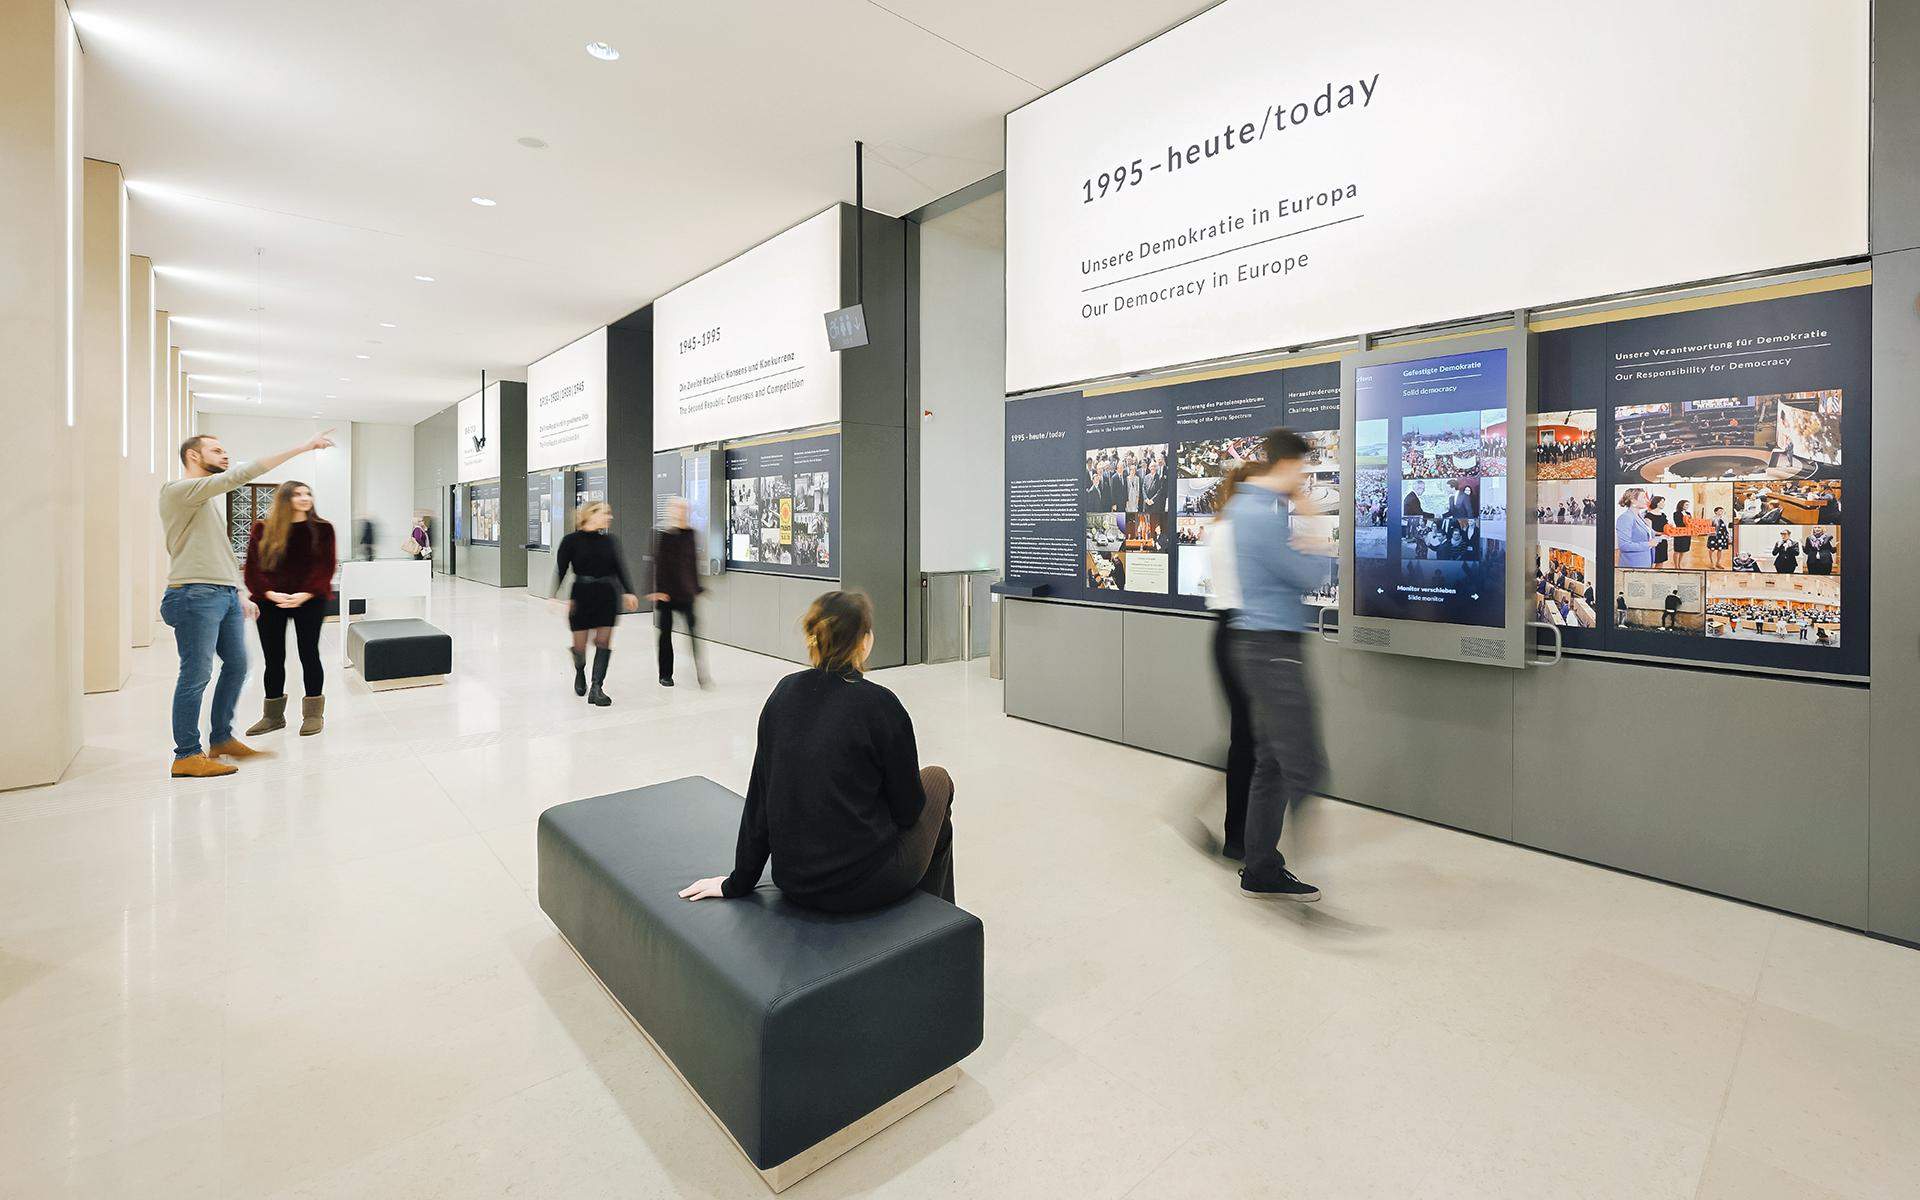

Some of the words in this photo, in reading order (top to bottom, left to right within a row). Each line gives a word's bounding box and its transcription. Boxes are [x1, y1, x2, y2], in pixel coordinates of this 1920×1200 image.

[1081, 248, 1134, 275] Unsere
[1139, 214, 1245, 260] Demokratie
[1252, 208, 1270, 225] in
[1278, 182, 1358, 218] Europa
[1081, 302, 1109, 319] Our
[1114, 277, 1205, 313] Democracy
[1213, 271, 1228, 288] in
[1238, 252, 1309, 282] Europe
[1615, 349, 1650, 361] Unsere
[1652, 340, 1733, 357] Verantwortung
[1736, 336, 1753, 348] für
[1756, 328, 1828, 345] Demokratie
[726, 366, 748, 379] Konsens
[748, 362, 759, 371] und
[759, 352, 795, 368] Konkurrenz
[1402, 367, 1438, 377] Gefestigte
[1439, 361, 1482, 373] Demokratie
[1615, 371, 1633, 381] Our
[1636, 365, 1707, 380] Responsibility
[1709, 362, 1725, 372] for
[1729, 357, 1792, 370] Democracy
[726, 391, 754, 404] Consensus
[755, 387, 765, 398] and
[766, 378, 804, 395] Competition
[1402, 388, 1420, 397] Solid
[1420, 385, 1457, 395] democracy
[1228, 413, 1252, 421] Spectrum
[1288, 405, 1319, 414] Challenges
[1396, 585, 1420, 593] Monitor
[1420, 585, 1457, 594] verschieben
[1421, 595, 1445, 603] monitor
